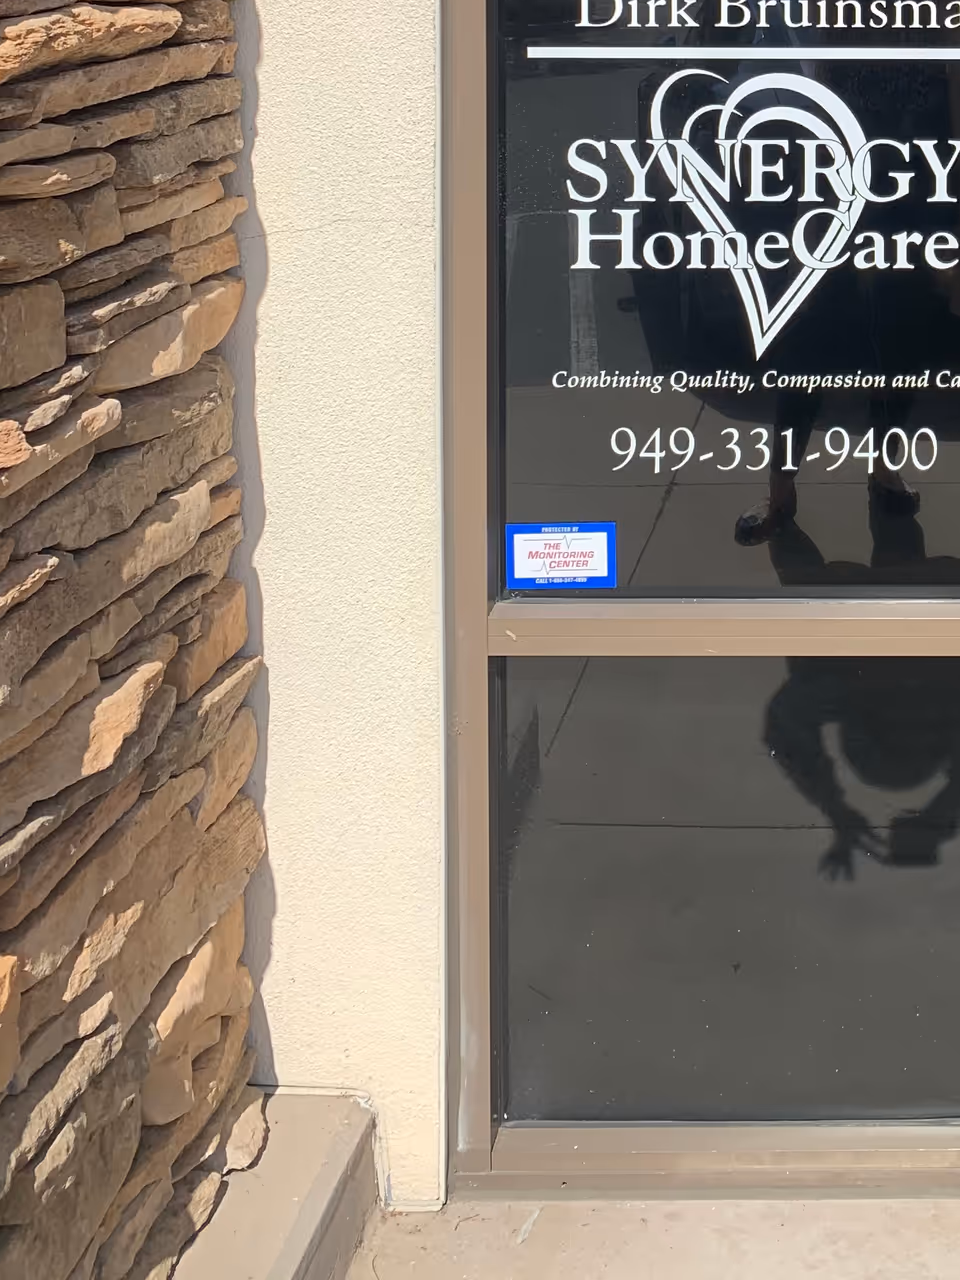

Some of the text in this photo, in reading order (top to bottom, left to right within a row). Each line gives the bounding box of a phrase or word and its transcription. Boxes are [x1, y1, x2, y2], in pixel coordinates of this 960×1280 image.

[567, 207, 960, 271] HomeCare
[551, 369, 663, 394] Combining
[669, 369, 755, 394] Quality,
[761, 370, 886, 394] Compassion
[890, 369, 931, 389] and
[609, 425, 939, 474] 949-331-9400
[543, 542, 562, 551] THE
